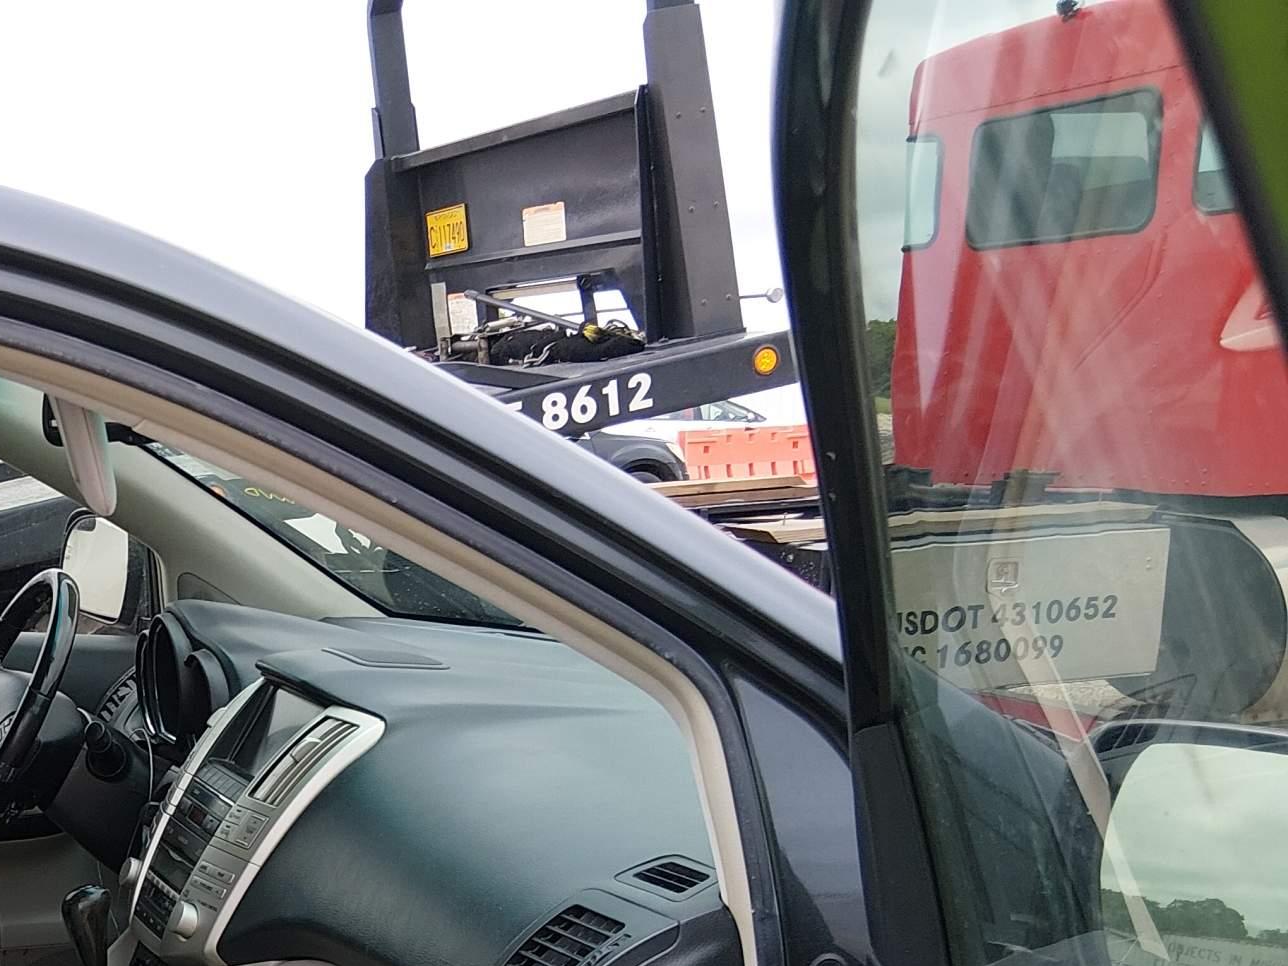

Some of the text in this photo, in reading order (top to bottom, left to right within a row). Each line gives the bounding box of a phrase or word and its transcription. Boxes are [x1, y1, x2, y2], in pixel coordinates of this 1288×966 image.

[542, 372, 654, 431] 8612
[991, 594, 1119, 626] 4310652
[937, 634, 1064, 669] 1680099
